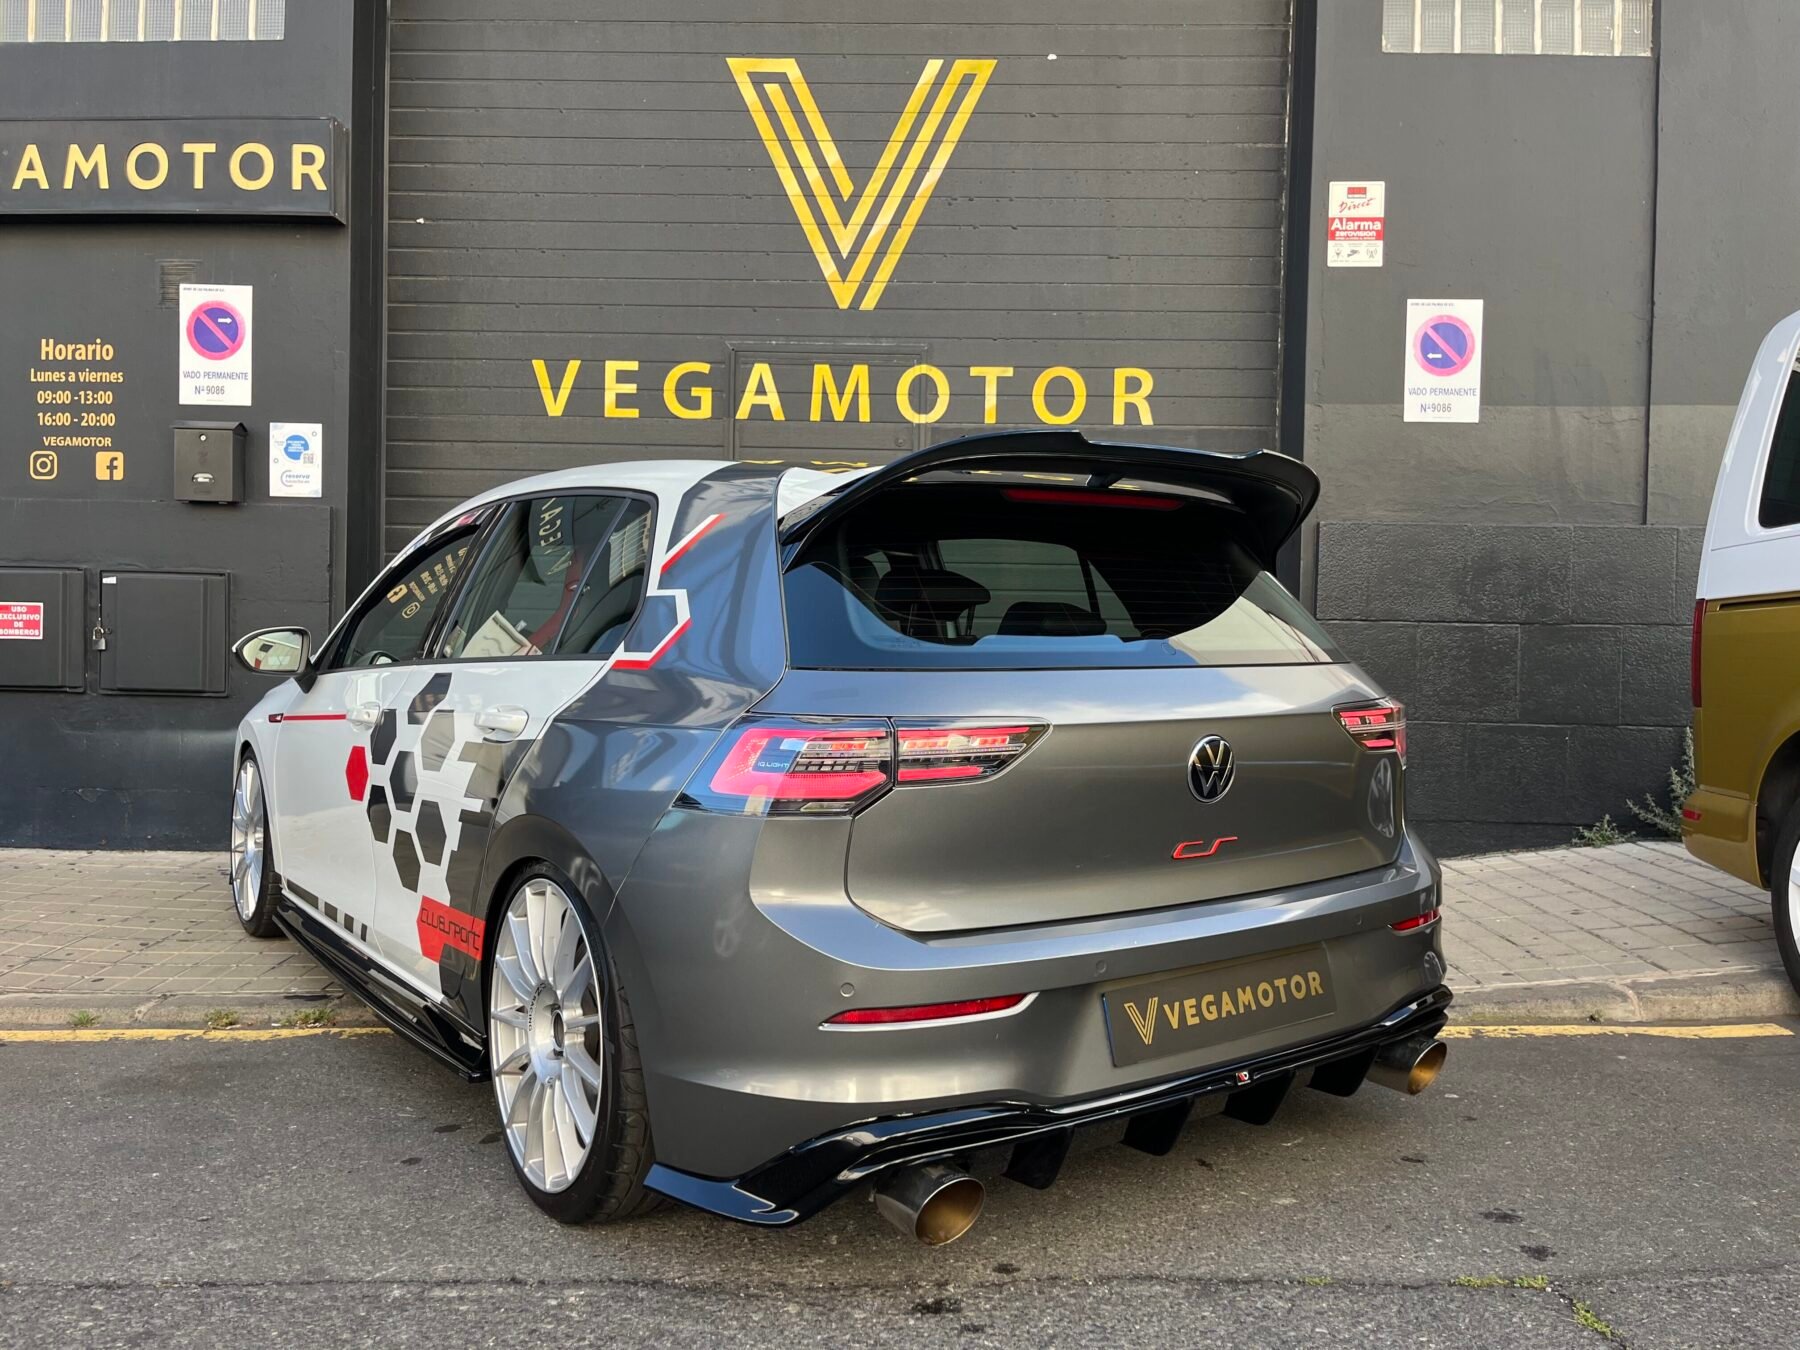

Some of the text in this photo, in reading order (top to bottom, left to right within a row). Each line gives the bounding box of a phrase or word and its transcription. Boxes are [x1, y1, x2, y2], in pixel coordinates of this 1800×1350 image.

[12, 142, 328, 191] AMOTOR
[1330, 217, 1382, 230] Alarma
[40, 338, 114, 361] Horario
[30, 368, 124, 383] Lunes a viernes
[183, 370, 248, 380] VADO PERMANENTE
[37, 390, 71, 404] 09:00
[531, 359, 1154, 426] VEGAMOTOR
[1408, 387, 1477, 397] VADO PERMANENTE
[37, 412, 71, 426] 16:00
[80, 413, 115, 426] 20:00
[43, 436, 112, 447] VEGAMOTOR
[1163, 971, 1324, 1029] VEGAMOTOR
